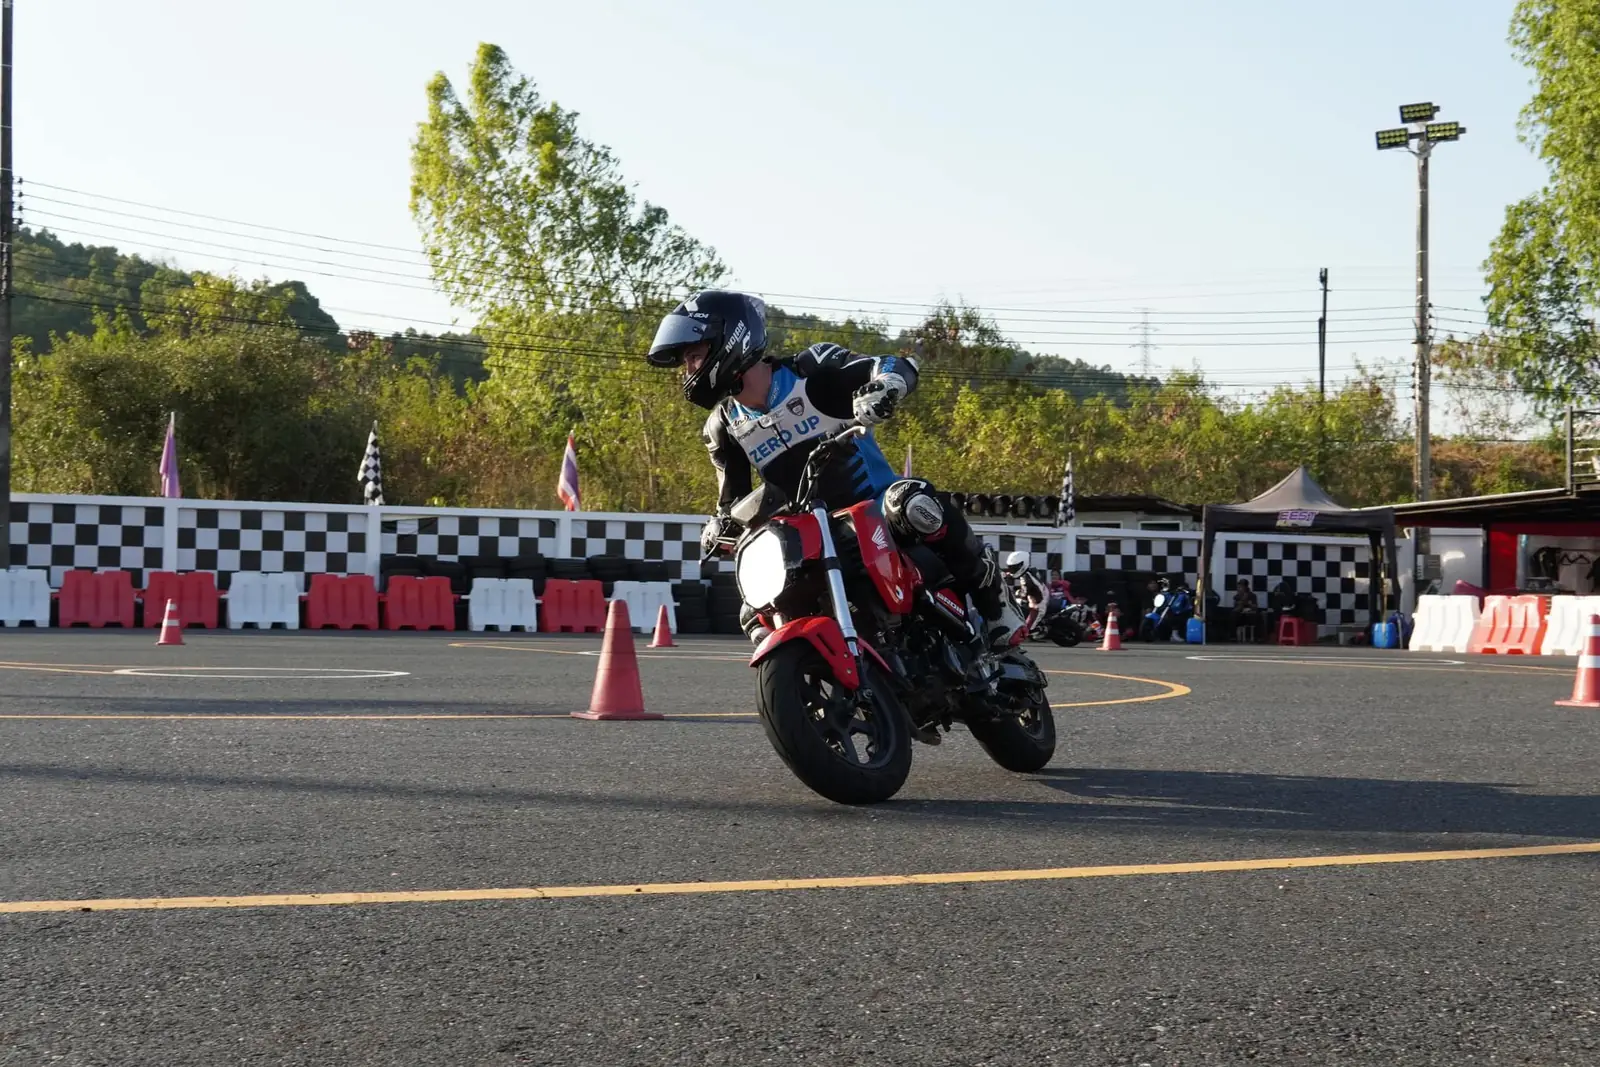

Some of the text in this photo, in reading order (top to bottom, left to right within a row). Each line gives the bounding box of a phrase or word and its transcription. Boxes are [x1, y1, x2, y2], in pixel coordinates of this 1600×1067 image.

[725, 319, 745, 353] NOLAN
[748, 429, 793, 464] ZERO
[794, 415, 820, 435] UP
